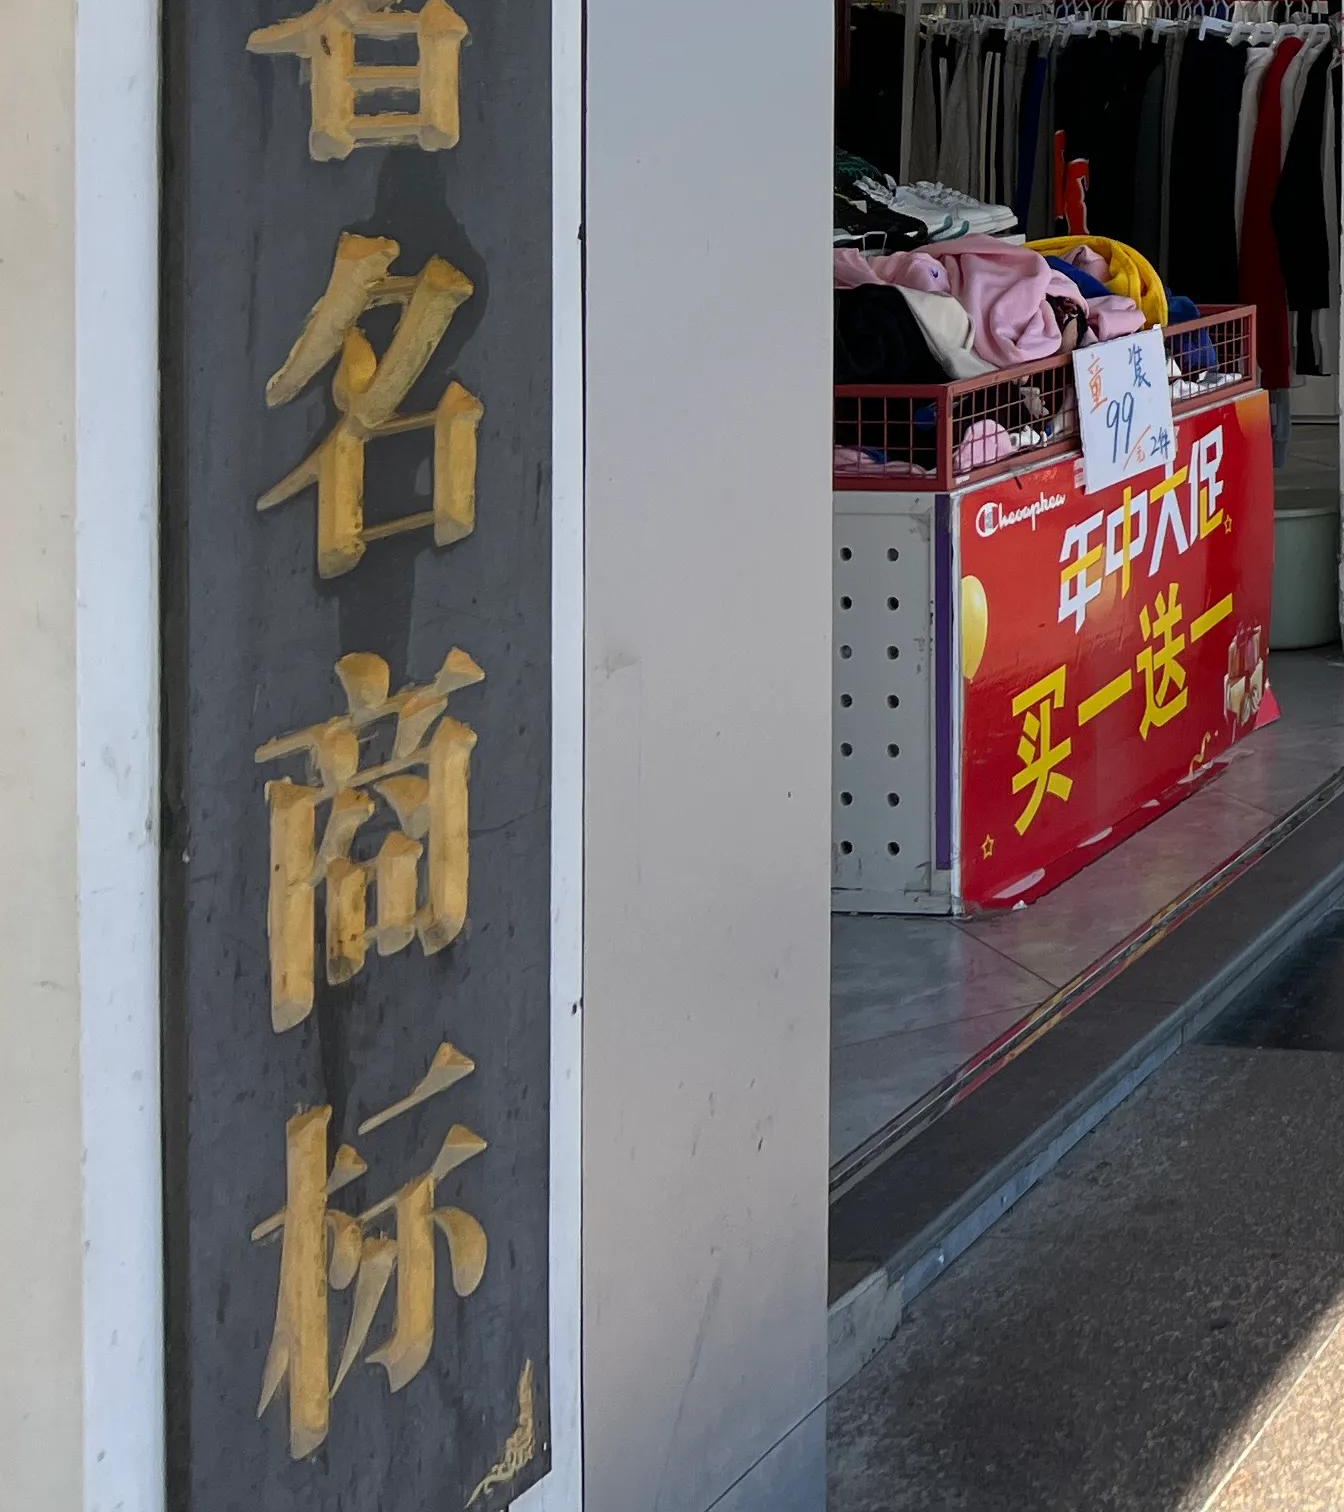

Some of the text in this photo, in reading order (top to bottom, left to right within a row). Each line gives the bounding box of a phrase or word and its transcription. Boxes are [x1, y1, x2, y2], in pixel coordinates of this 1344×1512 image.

[1057, 423, 1226, 634] 年中大促
[1011, 582, 1235, 838] 买一送一
